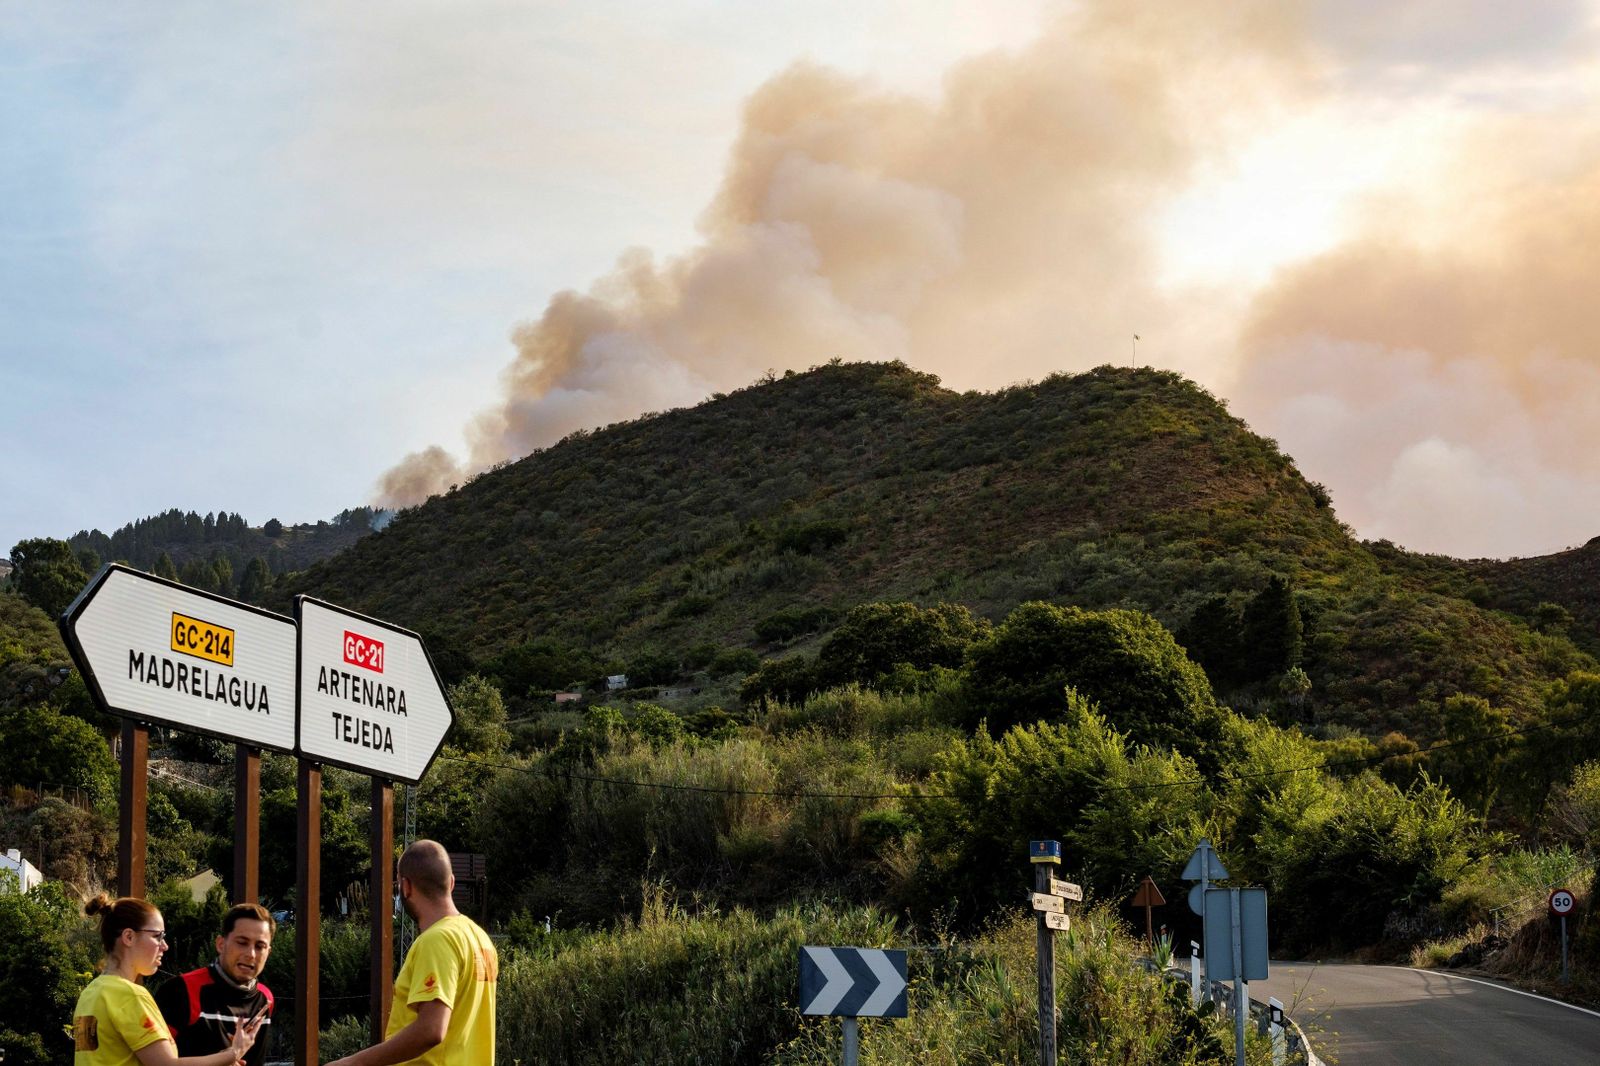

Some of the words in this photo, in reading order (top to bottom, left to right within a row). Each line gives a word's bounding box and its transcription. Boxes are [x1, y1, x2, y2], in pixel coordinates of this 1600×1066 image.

[175, 621, 231, 659] GC-214
[345, 636, 383, 669] GC-21
[129, 649, 270, 715] MADRELAGUA
[317, 665, 408, 717] ARTENARA
[332, 712, 394, 754] TEJEDA
[1554, 897, 1571, 907] 50
